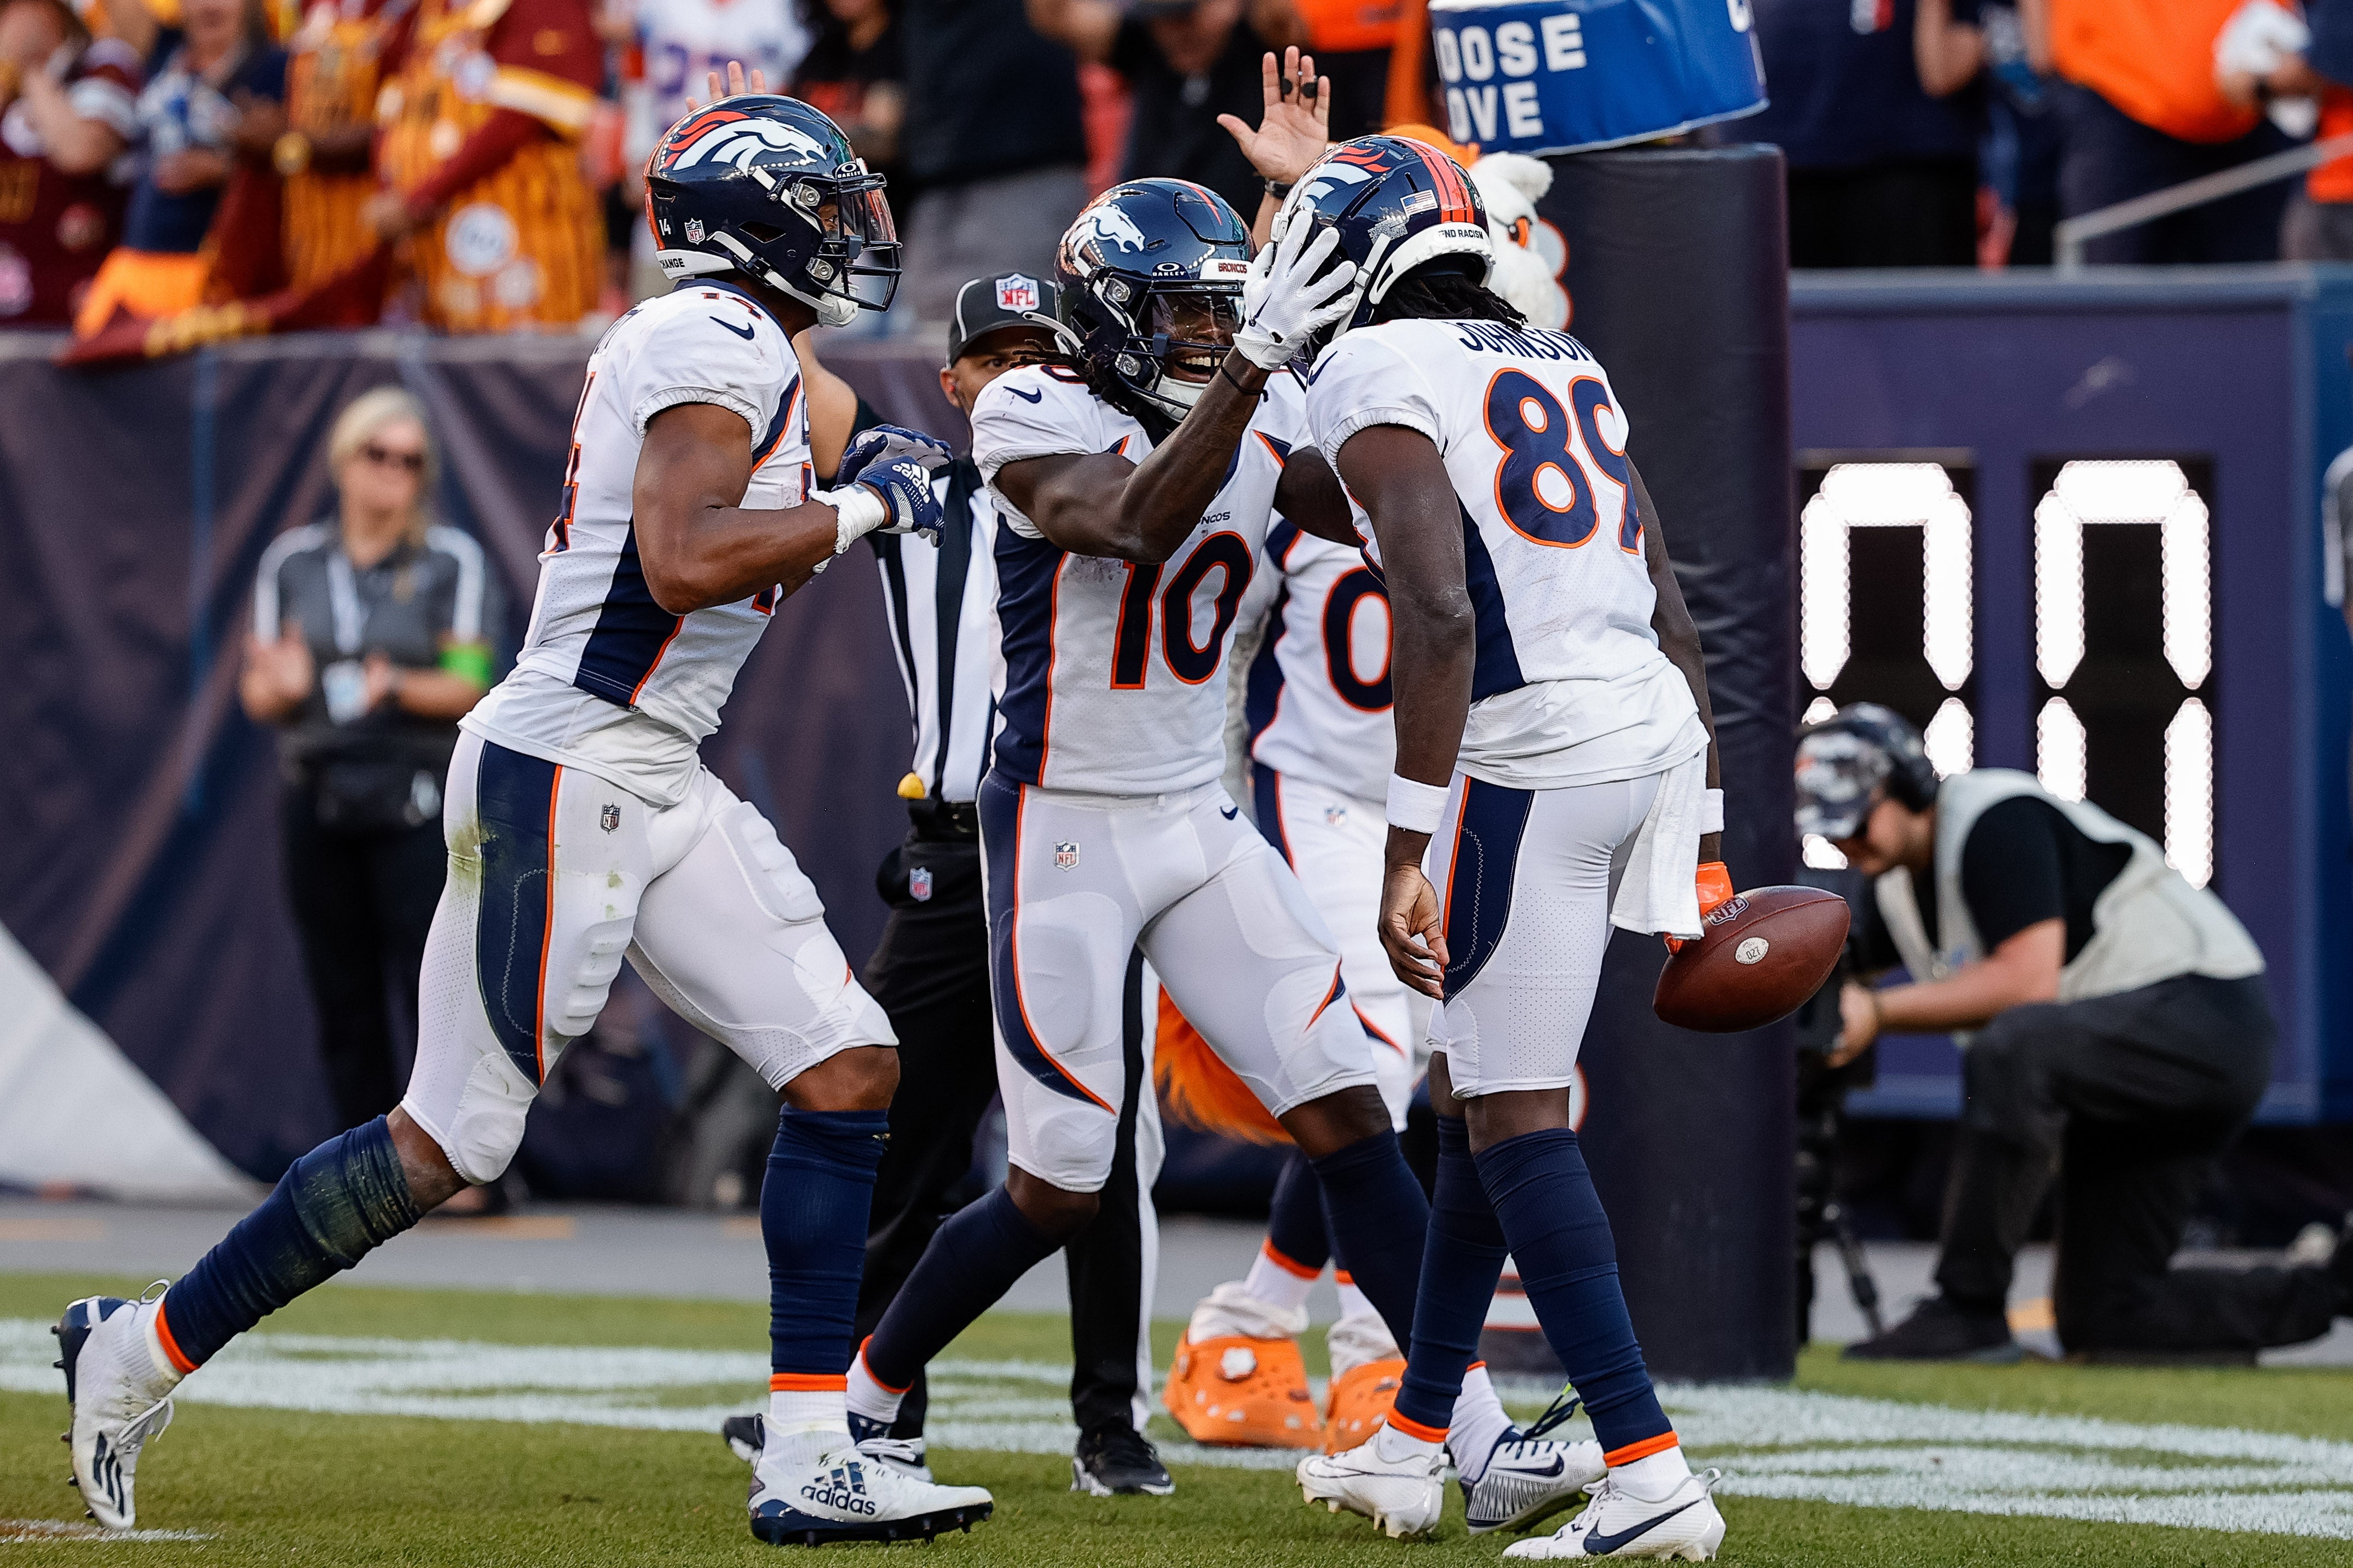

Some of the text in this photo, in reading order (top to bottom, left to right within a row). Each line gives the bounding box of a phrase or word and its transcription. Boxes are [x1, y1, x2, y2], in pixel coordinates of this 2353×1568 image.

[1473, 193, 1484, 212] 89
[659, 218, 672, 236] 14
[1457, 229, 1484, 240] RACISM
[659, 258, 685, 269] HANGE
[1218, 262, 1247, 274] BRONCOS
[1001, 289, 1036, 306] NFL
[1483, 367, 1645, 556] 89
[891, 464, 931, 504] adidas
[1200, 511, 1231, 525] NCOS
[1110, 530, 1254, 690] 10
[1714, 897, 1744, 921] NFL
[1746, 945, 1761, 960] 027
[800, 1485, 876, 1516] adidas
